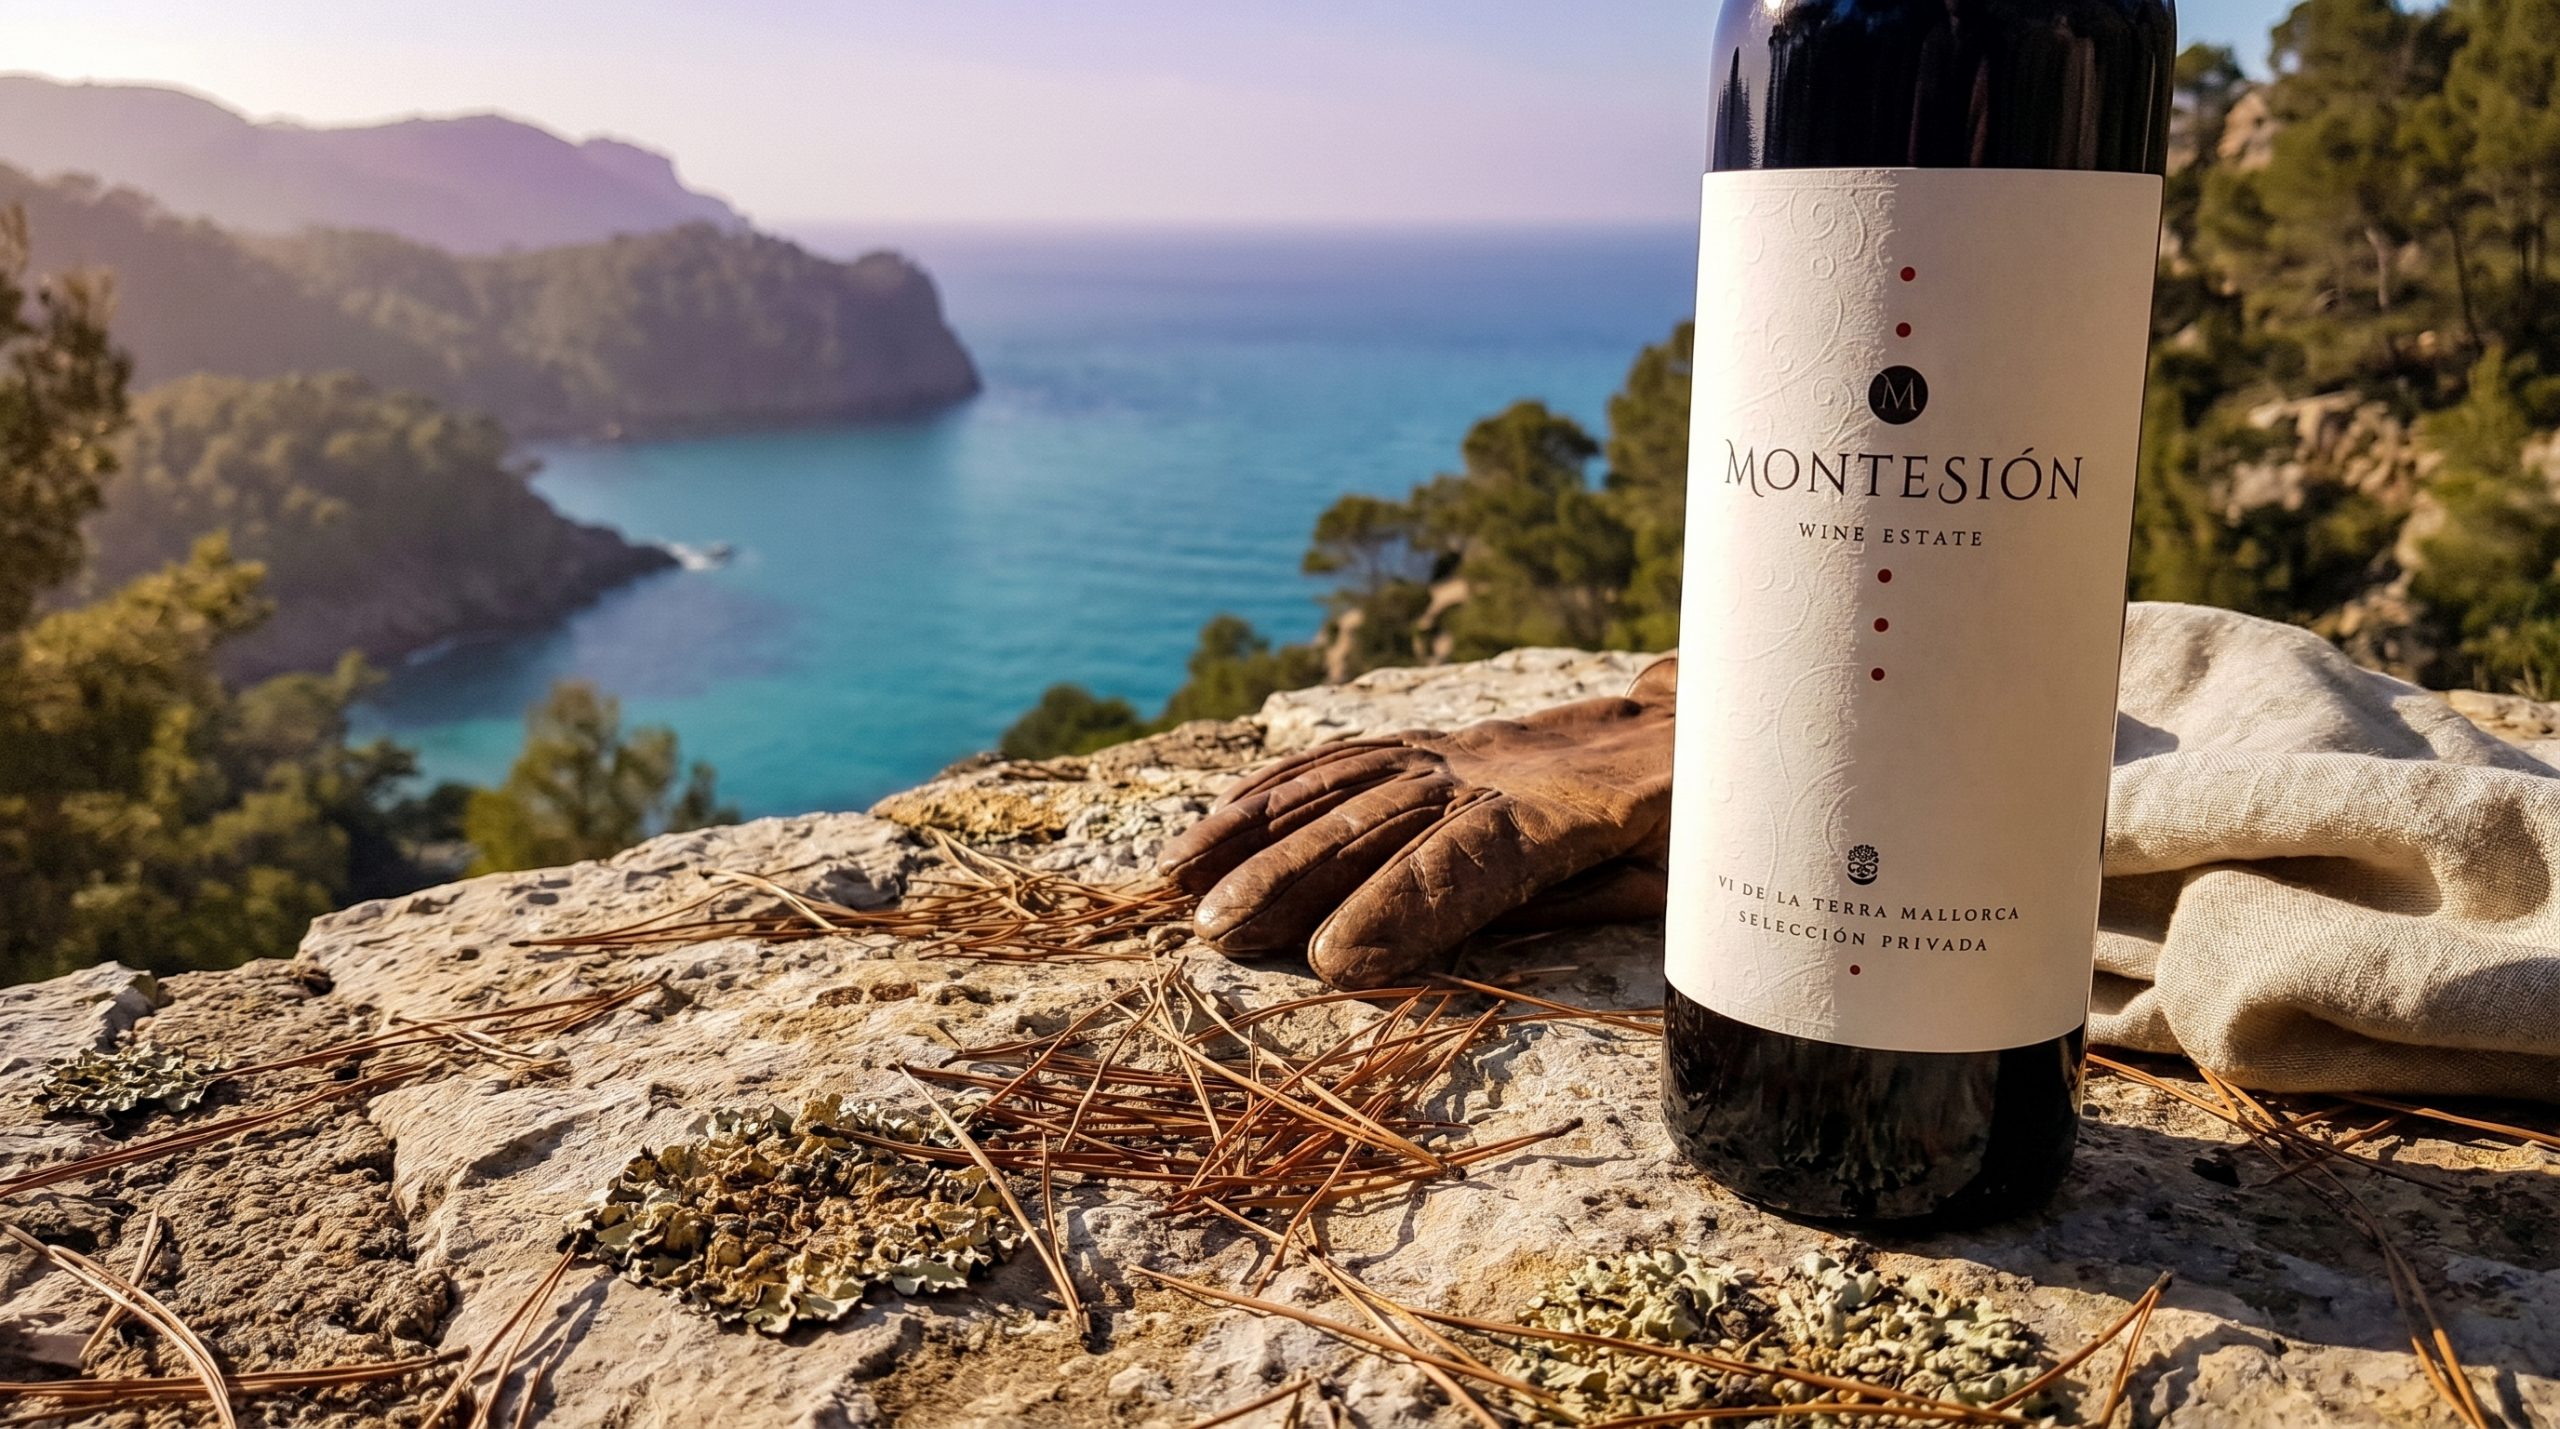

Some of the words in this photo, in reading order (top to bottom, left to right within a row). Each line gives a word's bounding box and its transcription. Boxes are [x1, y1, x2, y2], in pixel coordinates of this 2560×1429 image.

[1880, 371, 1917, 412] M
[1724, 438, 2084, 505] MONTESIÓN
[1798, 522, 1865, 542] WINE
[1883, 528, 1983, 547] ESTATE
[1718, 875, 1734, 891] VI
[1742, 883, 1766, 900] DE
[1777, 891, 1801, 907] LA
[1812, 897, 1887, 918] TERRA
[1900, 906, 2020, 922] MALLORCA
[1738, 910, 1866, 945] SELECCIÓN
[1882, 935, 1988, 952] PRIVADA
